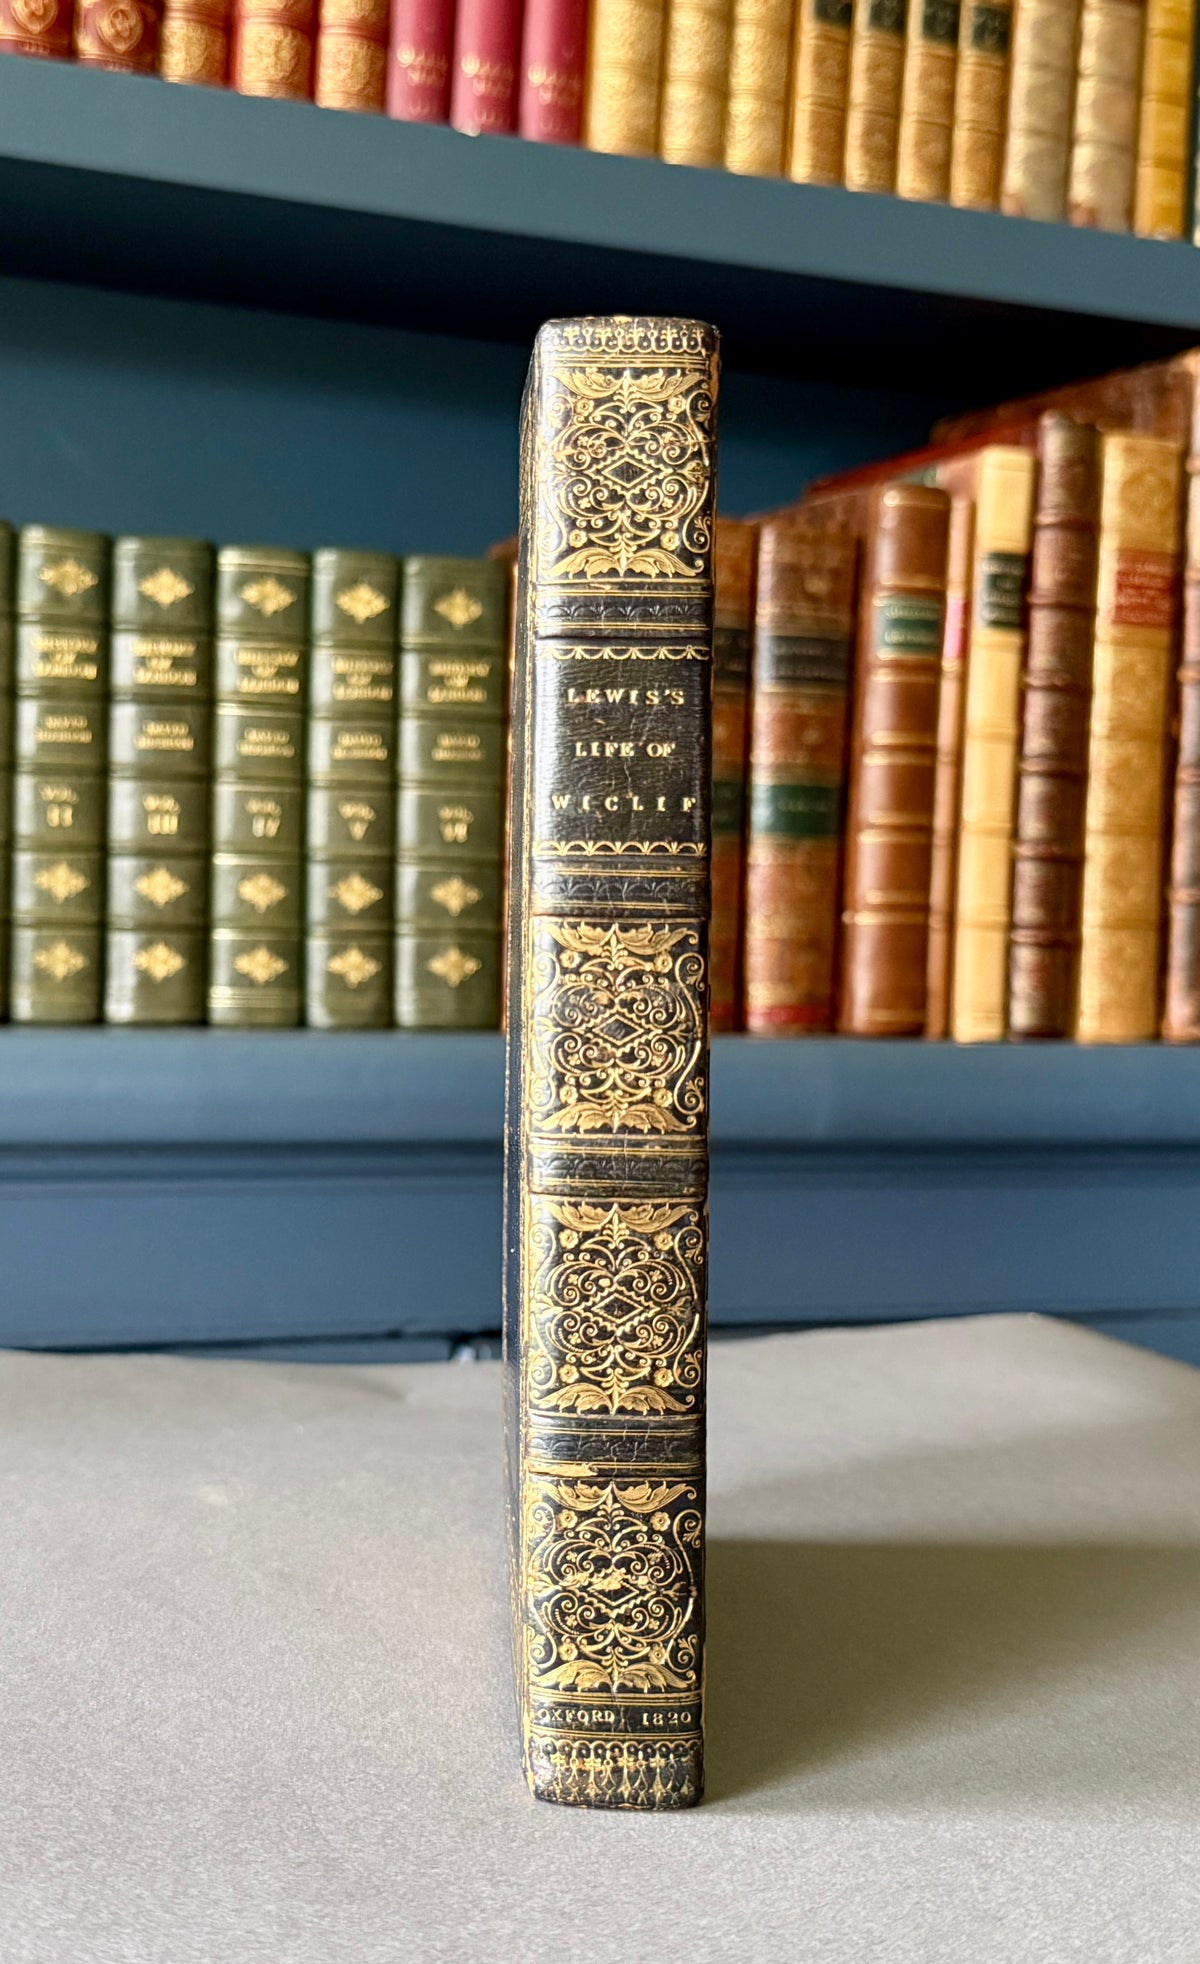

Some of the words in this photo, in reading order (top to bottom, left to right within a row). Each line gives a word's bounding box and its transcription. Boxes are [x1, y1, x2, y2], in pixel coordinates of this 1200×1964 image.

[566, 687, 685, 706] LEWIS'S
[575, 741, 635, 758] LIFE
[646, 742, 676, 758] OF
[551, 794, 697, 812] WICLIF
[537, 1708, 616, 1726] OXFORD
[641, 1711, 692, 1726] 1820
